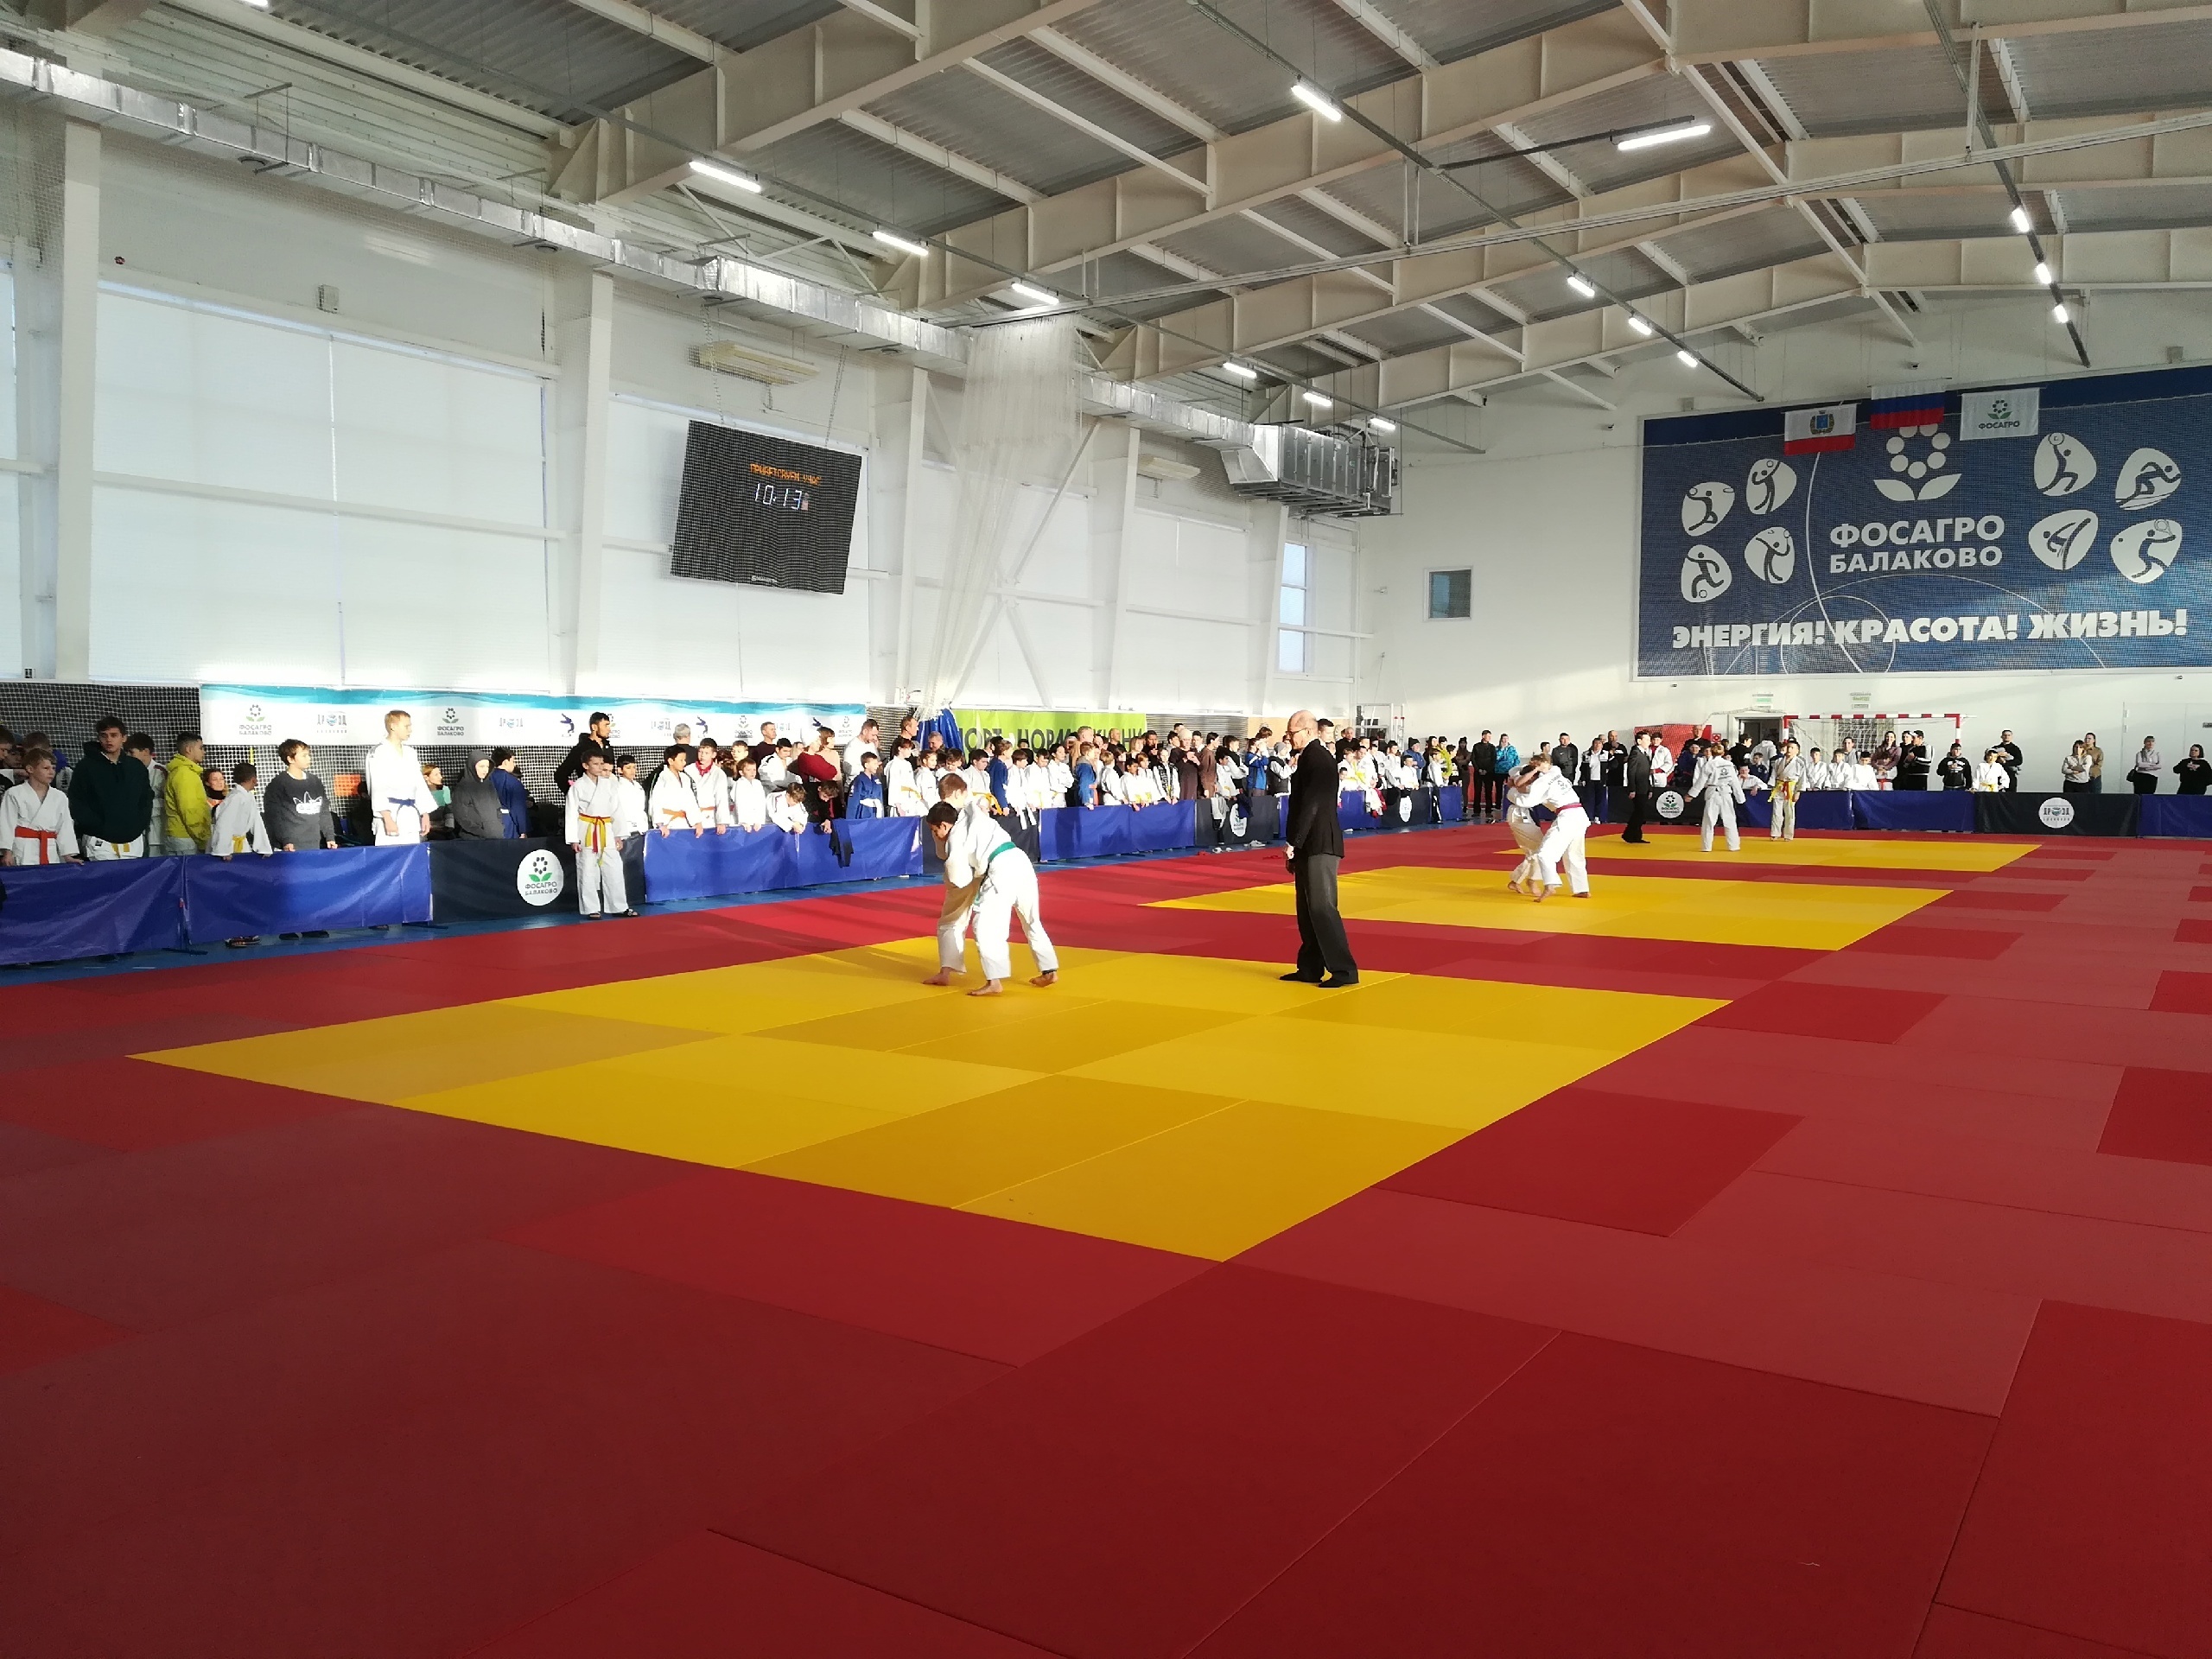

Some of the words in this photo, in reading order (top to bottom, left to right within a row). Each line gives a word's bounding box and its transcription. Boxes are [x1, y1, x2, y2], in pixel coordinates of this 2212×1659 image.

[1978, 420, 2020, 429] ФОСАГРО
[1830, 515, 2005, 548] ФОСАГРО
[1829, 545, 2003, 573] БАЛАКОВО
[1672, 620, 1826, 648] ЭНЕРГИЯ!
[1834, 614, 2018, 644] КРАСОТА!
[2027, 608, 2188, 639] ЖИЗНЬ!
